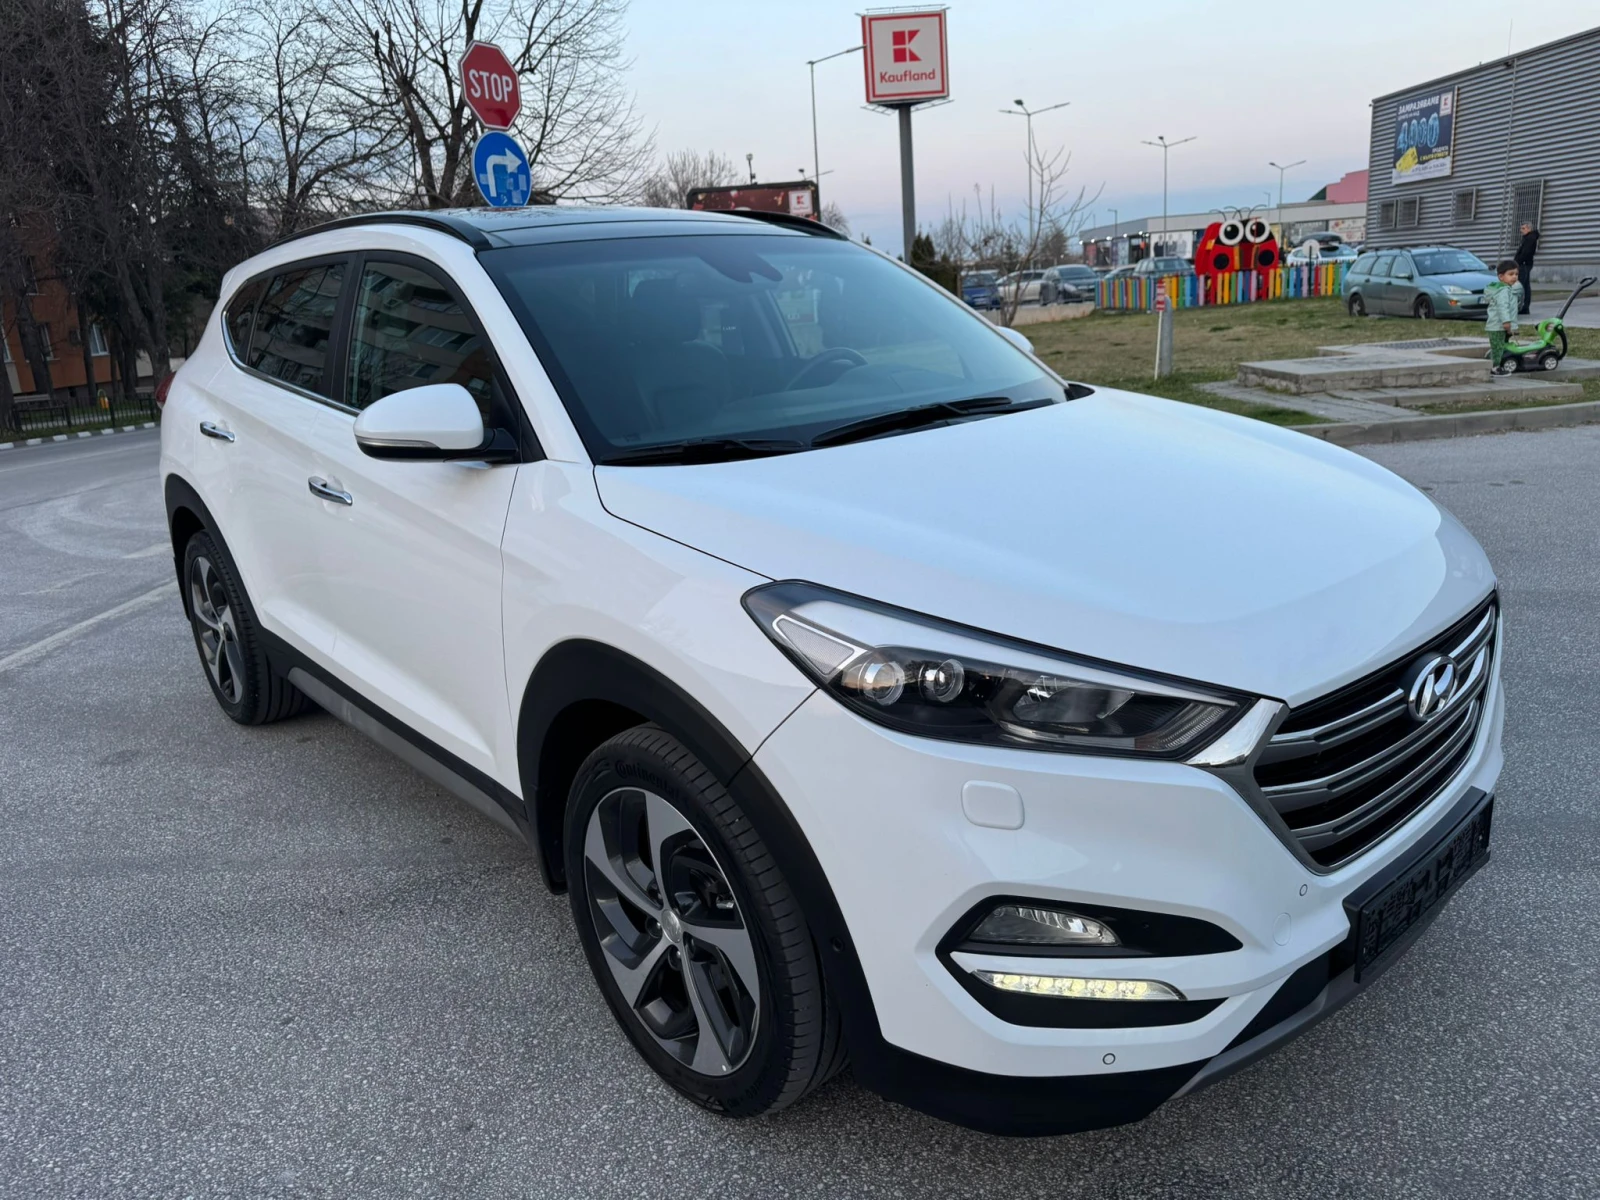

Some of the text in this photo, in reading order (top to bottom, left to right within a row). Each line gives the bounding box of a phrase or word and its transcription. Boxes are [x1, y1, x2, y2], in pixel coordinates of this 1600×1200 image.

[468, 68, 513, 103] STOP
[879, 68, 936, 83] Kaufland
[614, 759, 679, 801] Continental
